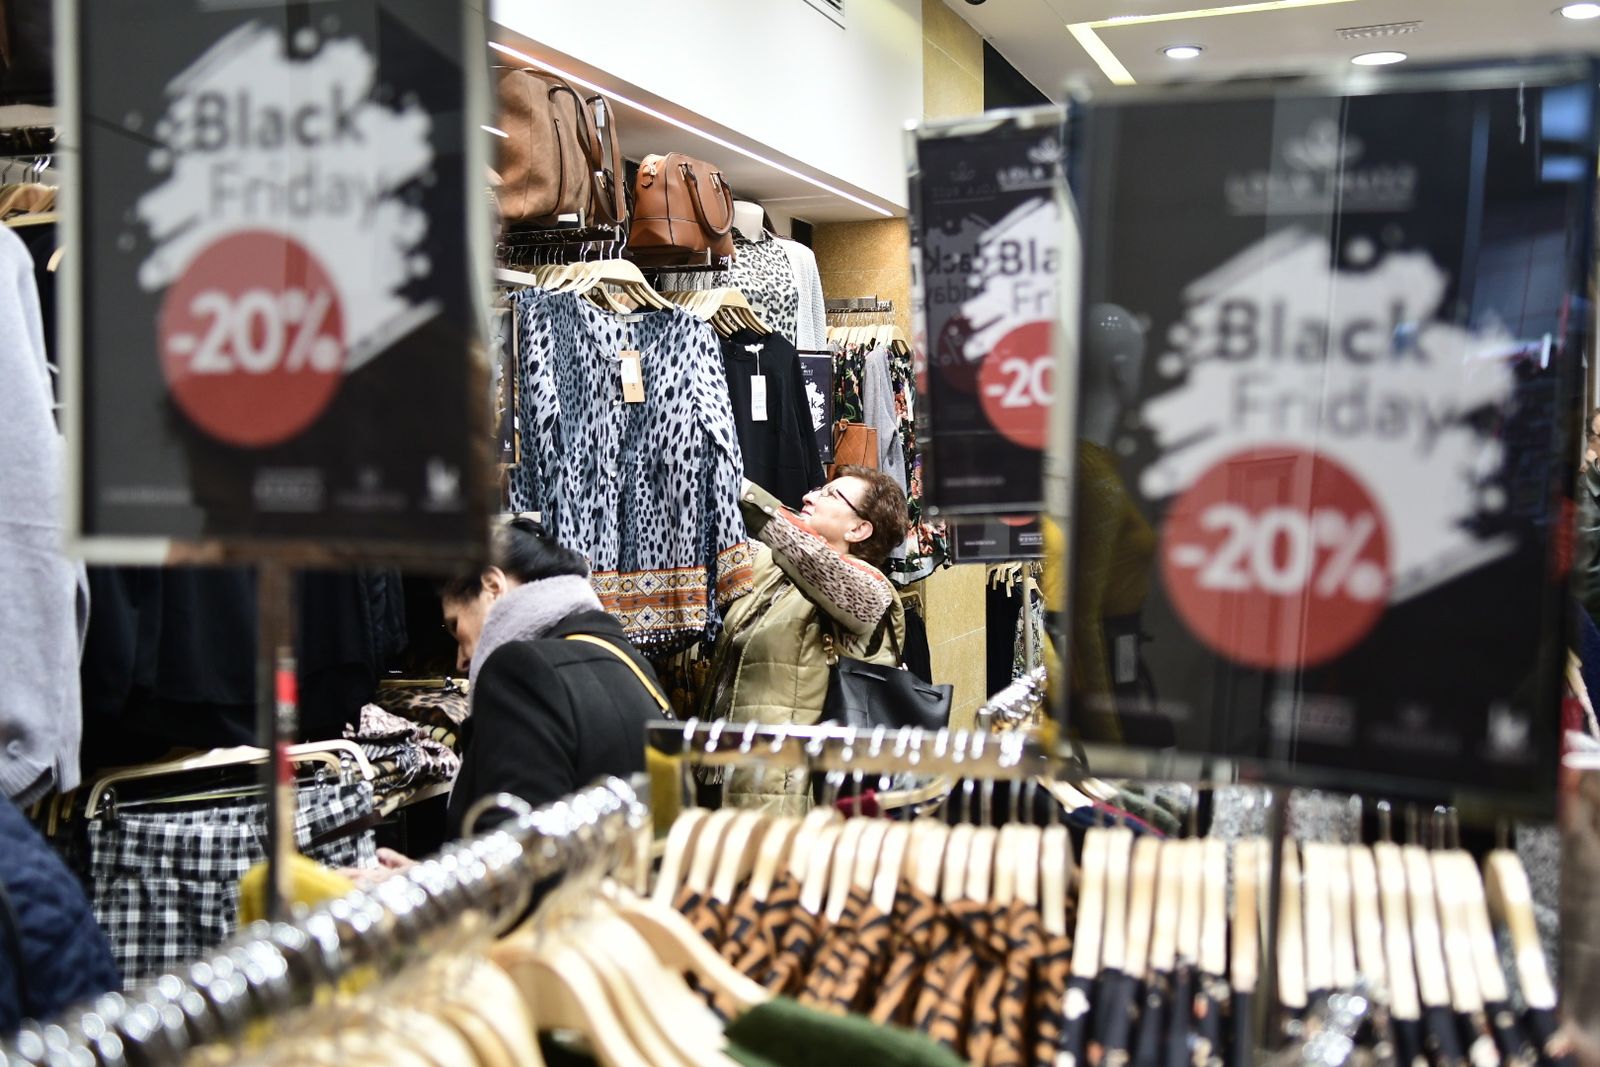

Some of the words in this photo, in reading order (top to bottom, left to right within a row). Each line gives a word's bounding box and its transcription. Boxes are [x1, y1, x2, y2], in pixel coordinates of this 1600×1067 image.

[194, 87, 364, 154] Black
[207, 164, 385, 231] Friday
[1001, 237, 1062, 277] Bla
[166, 288, 342, 373] -20%
[1217, 297, 1428, 365] Black
[985, 354, 1057, 408] -20
[1231, 374, 1454, 452] Friday
[1170, 504, 1390, 600] -20%
